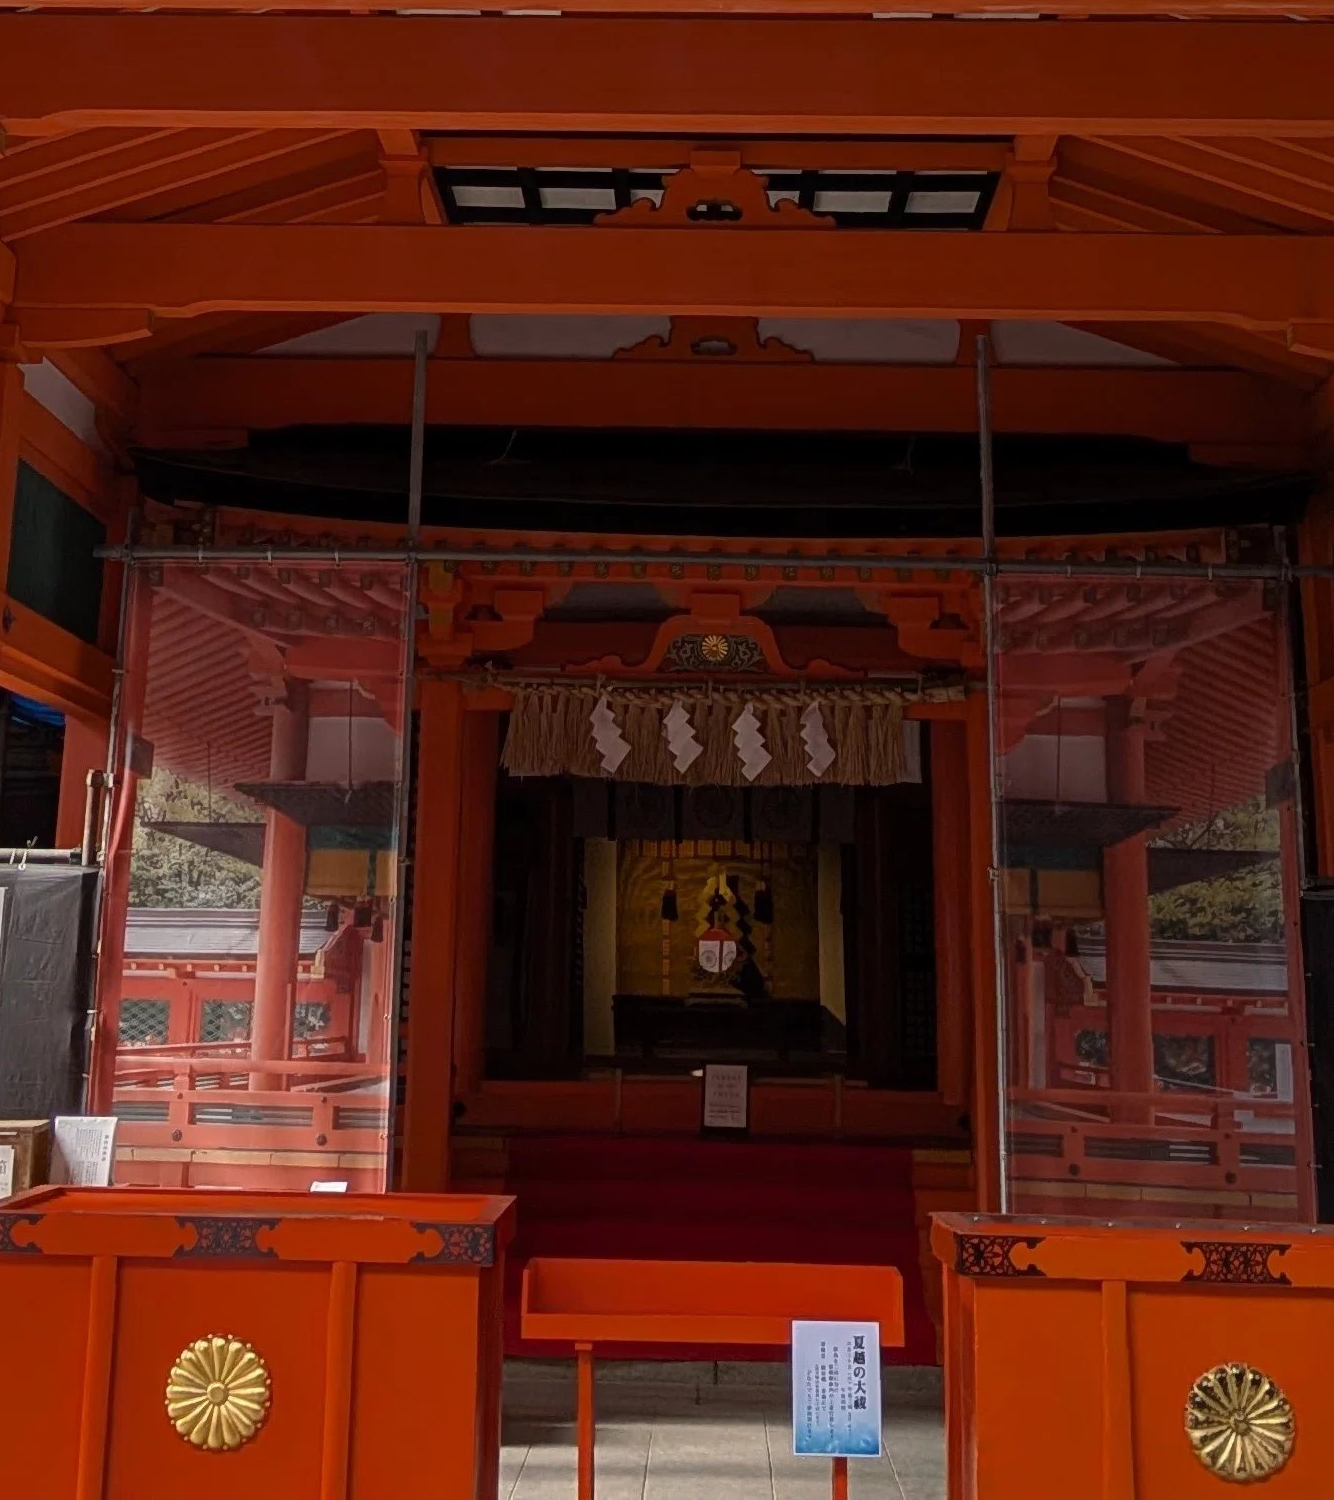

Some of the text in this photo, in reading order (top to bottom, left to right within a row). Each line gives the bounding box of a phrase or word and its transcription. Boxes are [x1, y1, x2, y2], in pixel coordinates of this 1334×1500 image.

[853, 1335, 867, 1410] 夏越の大祓
